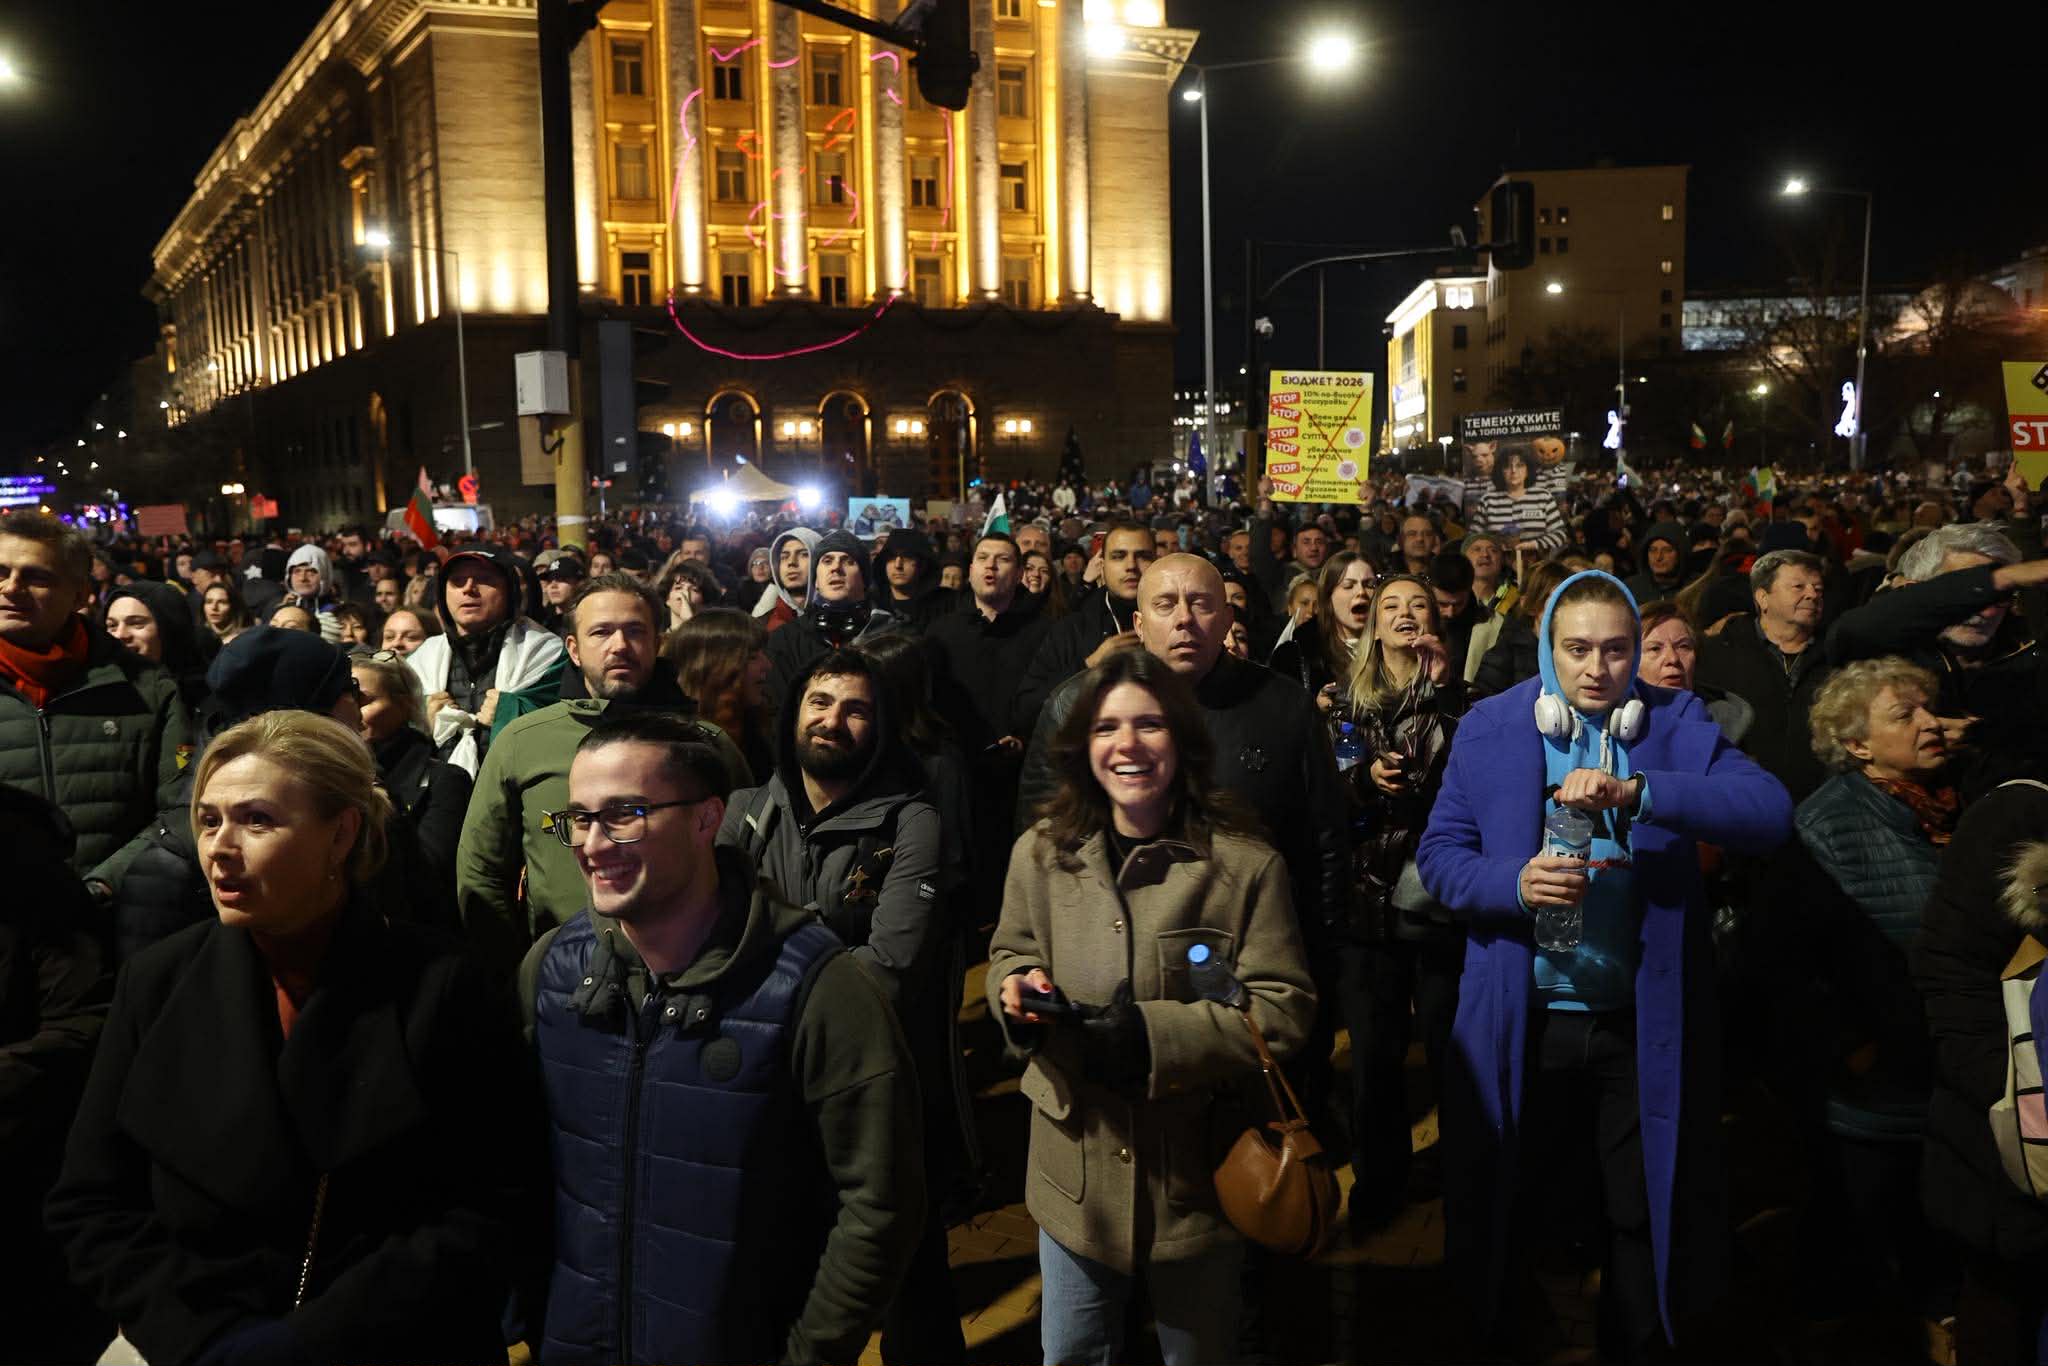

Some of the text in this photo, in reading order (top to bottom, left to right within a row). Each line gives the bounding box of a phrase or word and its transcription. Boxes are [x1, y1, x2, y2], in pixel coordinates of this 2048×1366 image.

[1281, 376, 1364, 387] БЮДЖЕТ 2026
[1271, 393, 1298, 405] STOP
[1272, 407, 1300, 420] STOP
[1464, 411, 1560, 429] ТЕМЕНУЖКИТЕ
[1270, 427, 1297, 439] STOP
[1479, 427, 1509, 436] ТОПЛО
[1510, 425, 1522, 433] ЗА
[1524, 422, 1560, 433] ЗИМАТА!
[1271, 441, 1298, 453] STOP
[1271, 463, 1297, 474] STOP
